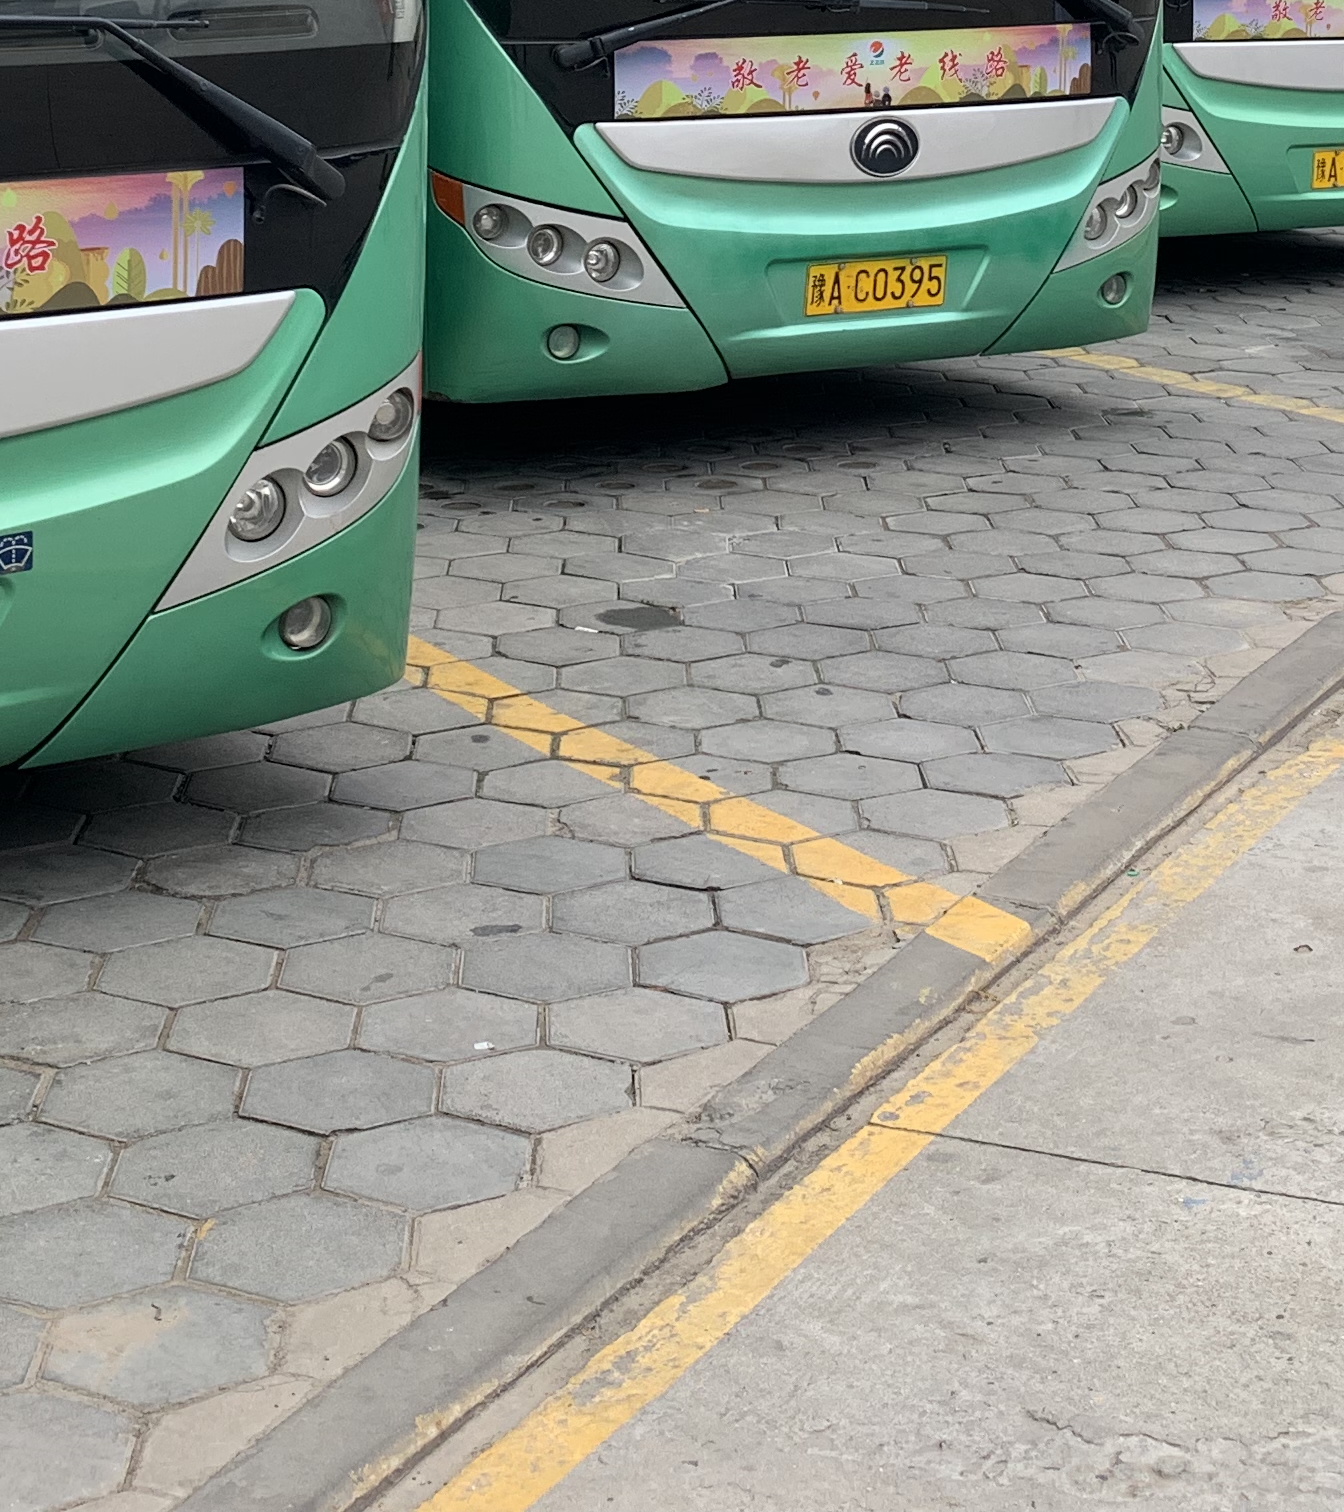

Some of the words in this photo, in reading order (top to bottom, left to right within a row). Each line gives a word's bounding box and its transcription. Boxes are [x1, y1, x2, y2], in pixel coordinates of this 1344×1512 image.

[729, 46, 1009, 92] 敬老爱老线路
